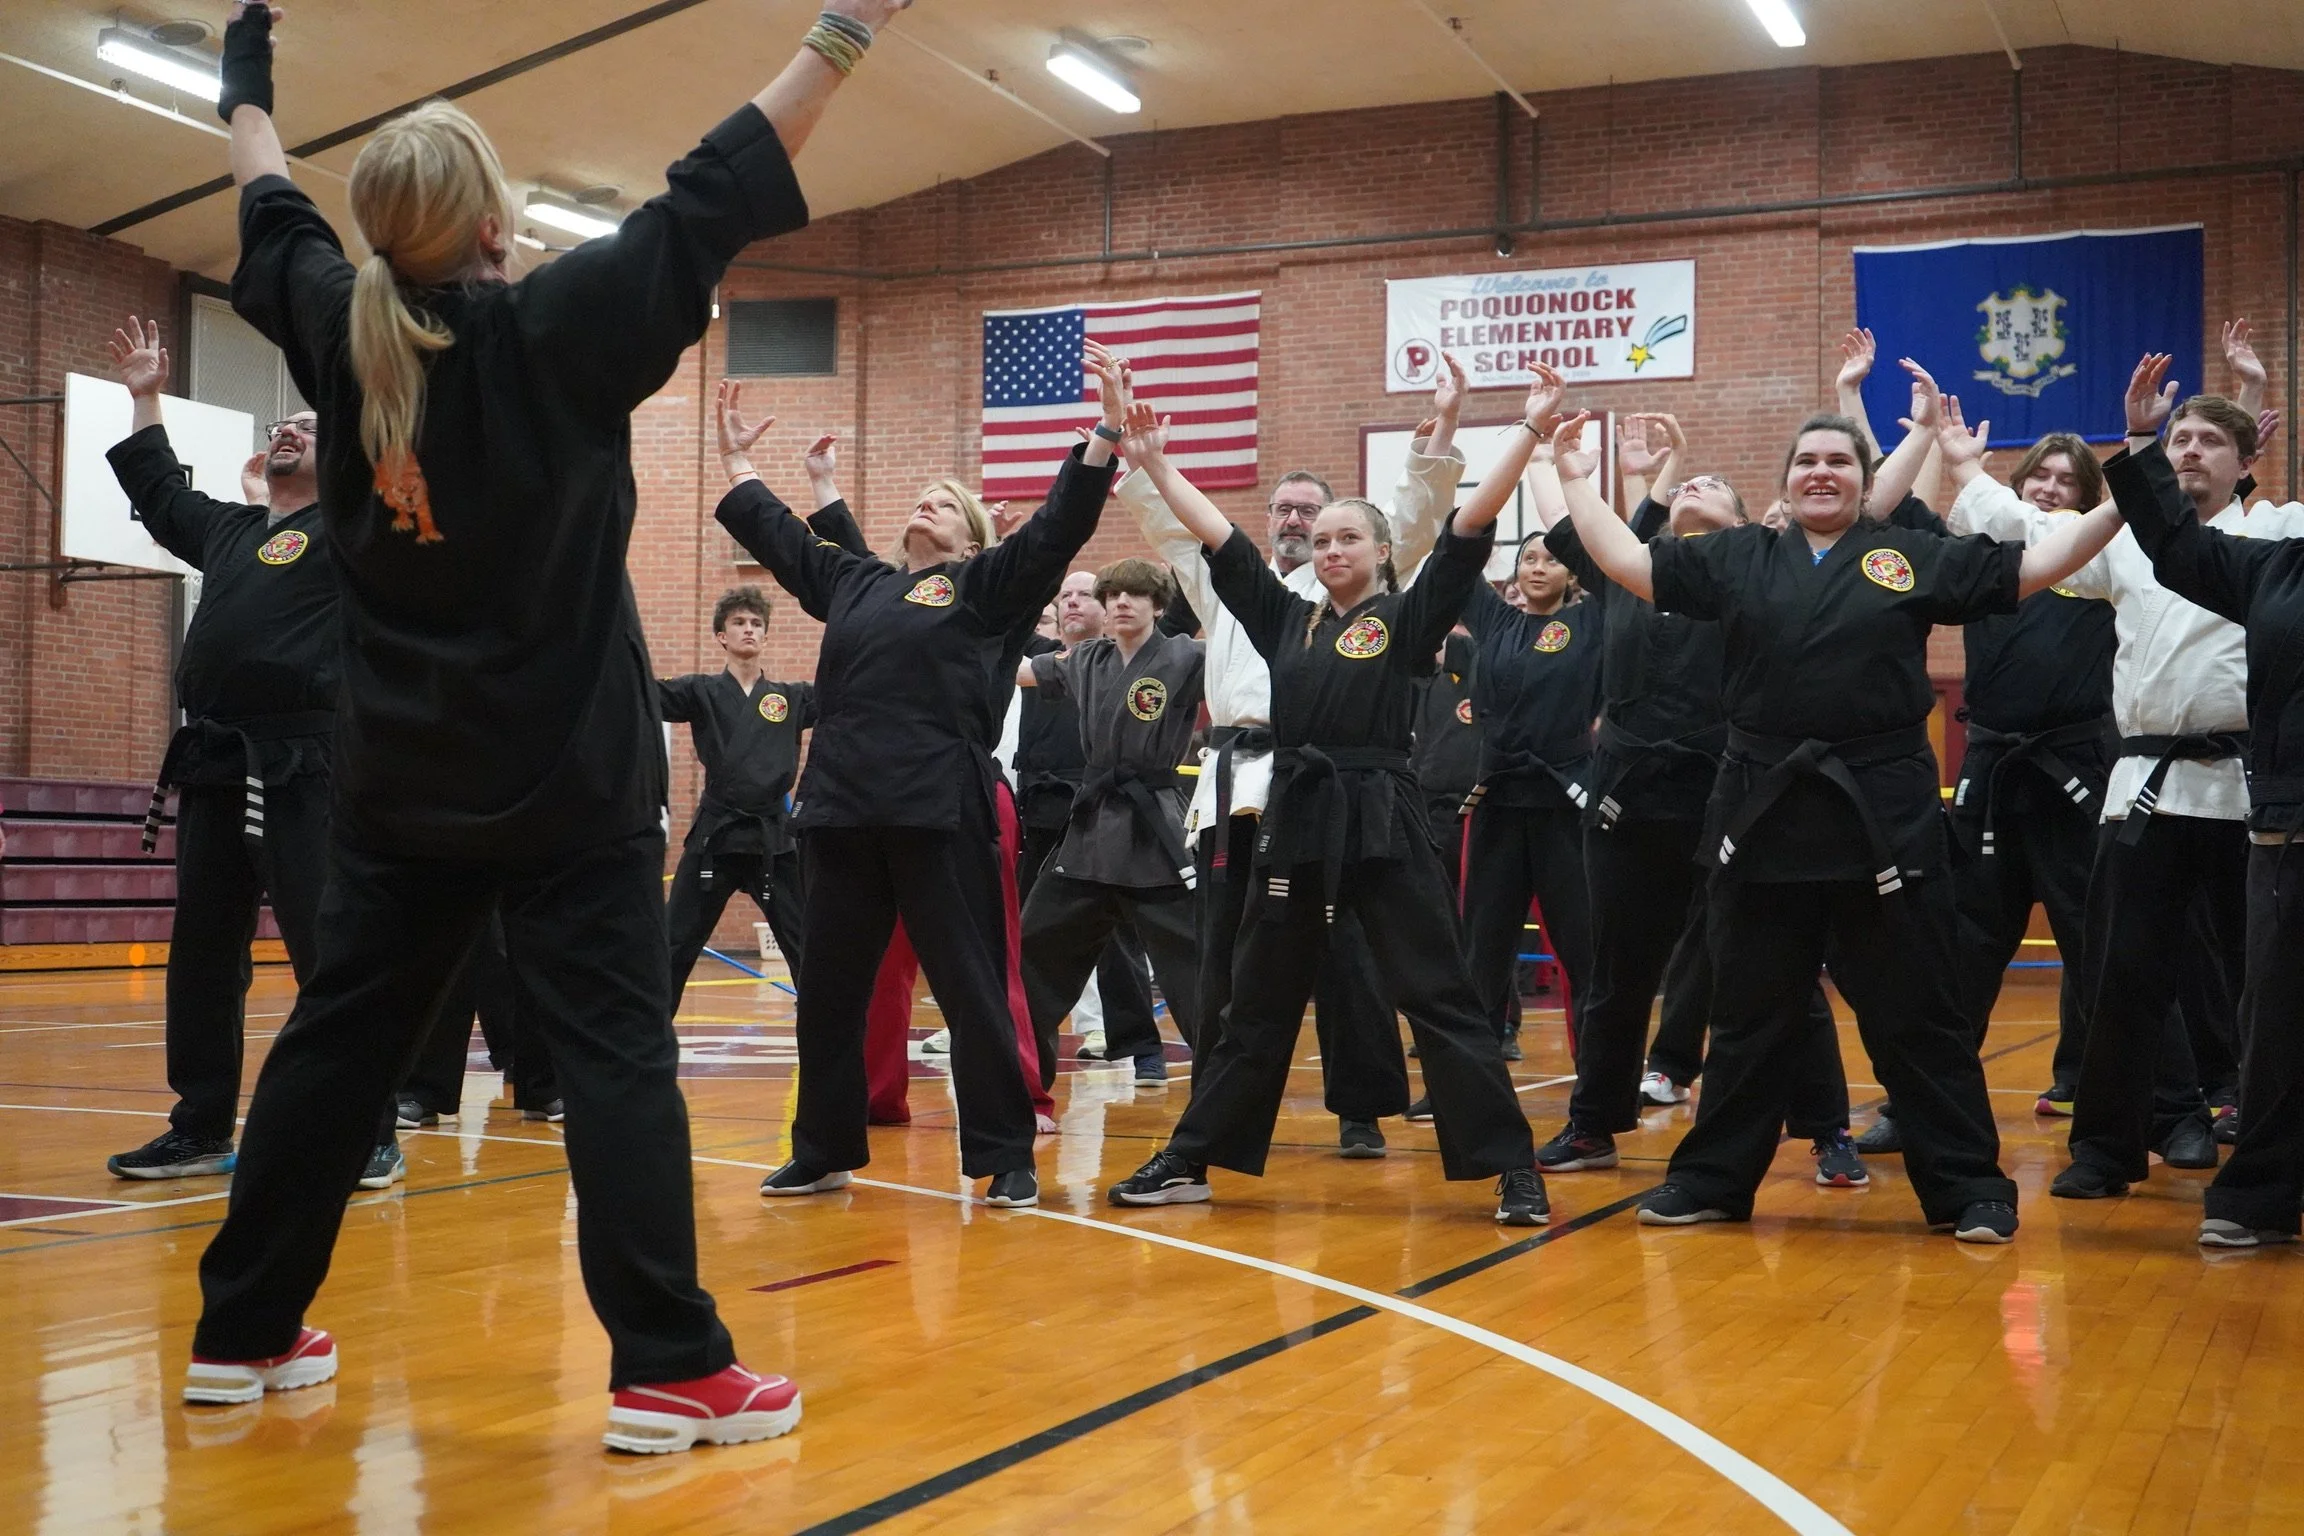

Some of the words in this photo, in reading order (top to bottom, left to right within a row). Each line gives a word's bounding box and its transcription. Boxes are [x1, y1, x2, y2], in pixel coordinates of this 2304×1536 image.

[1471, 275, 1578, 294] Welcome
[1584, 270, 1609, 288] to
[1440, 288, 1636, 320] POQUONOCK
[1440, 316, 1634, 348] ELEMENTARY
[1406, 346, 1430, 377] P
[1474, 347, 1599, 373] SCHOOL
